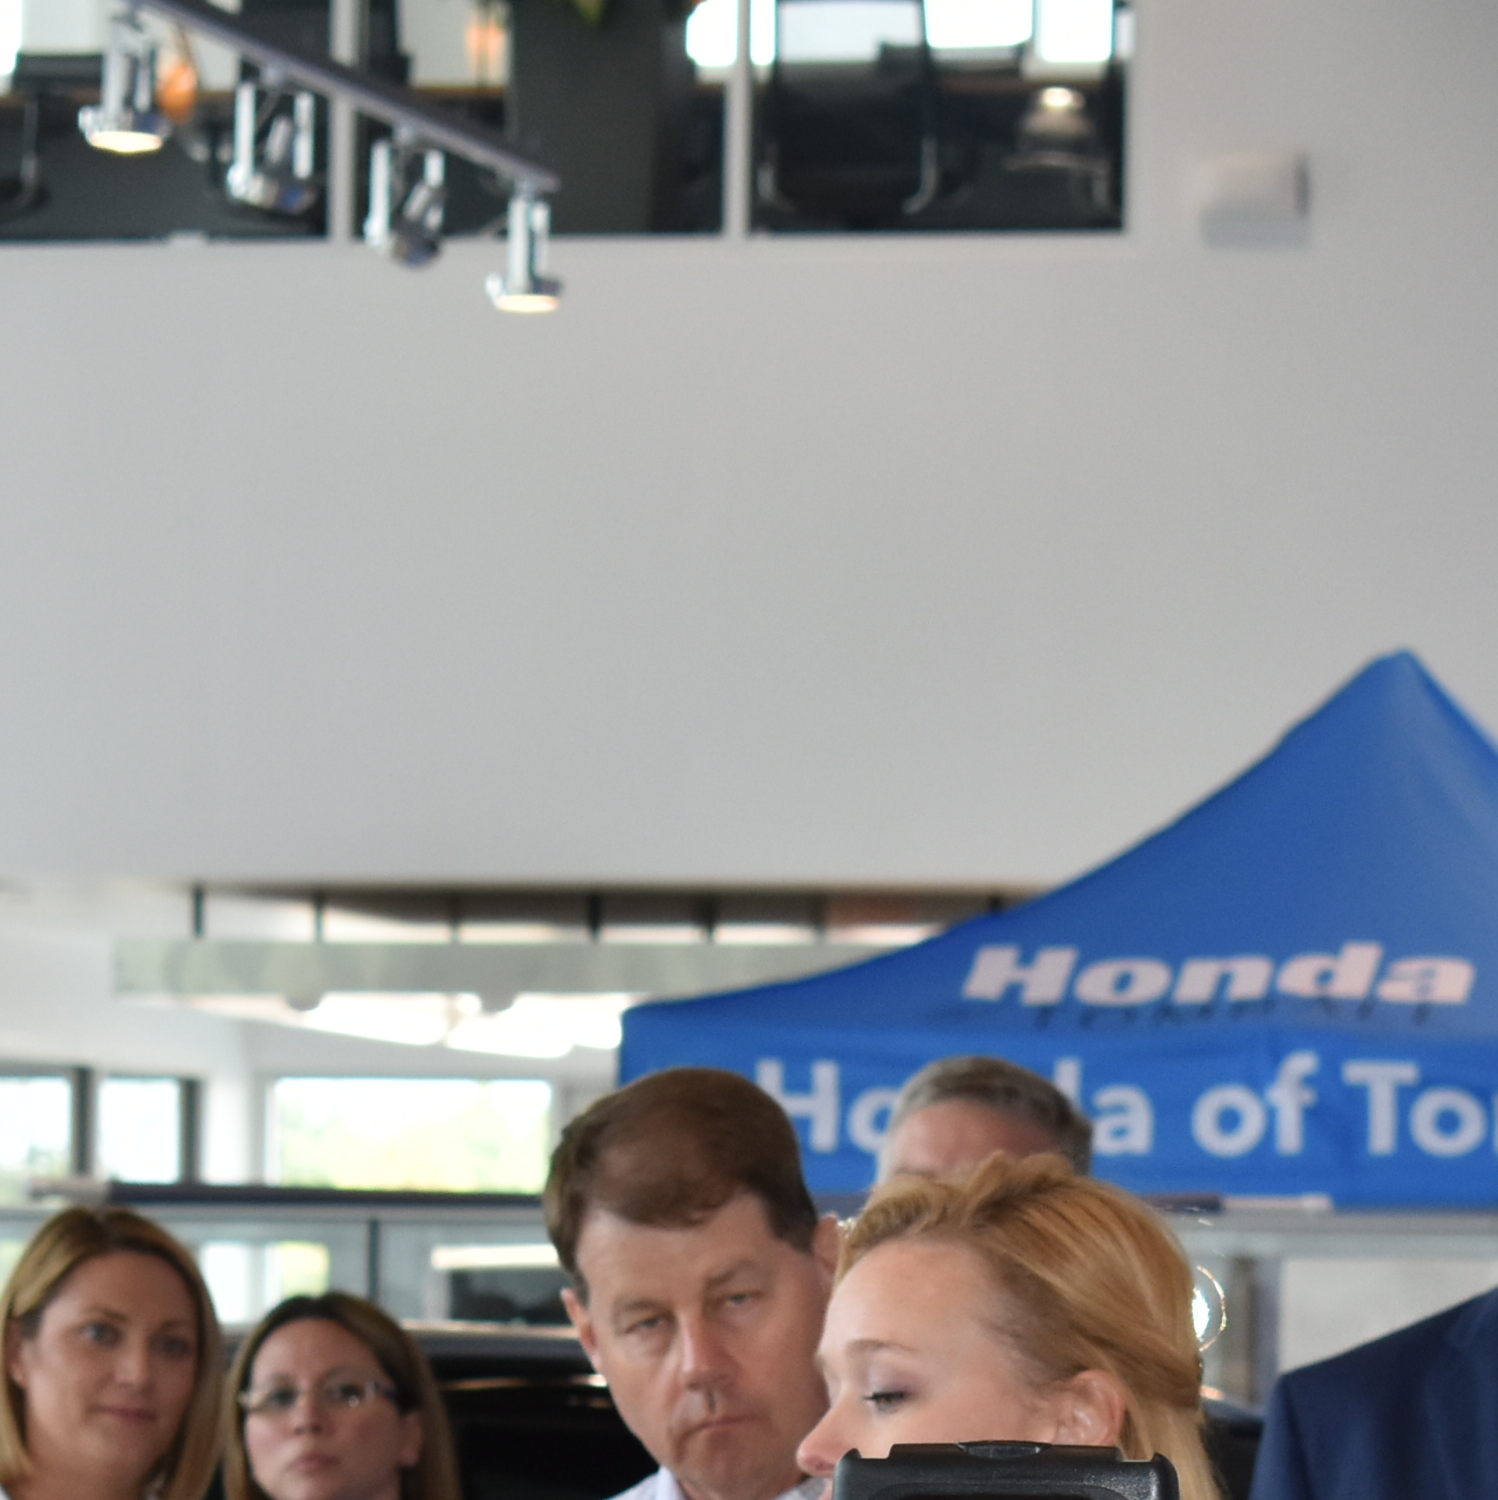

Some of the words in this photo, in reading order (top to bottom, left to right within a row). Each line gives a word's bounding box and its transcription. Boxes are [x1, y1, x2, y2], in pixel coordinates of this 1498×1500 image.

[962, 941, 1476, 1005] Honda
[755, 1056, 1155, 1156] Hoa
[1191, 1050, 1319, 1157] of
